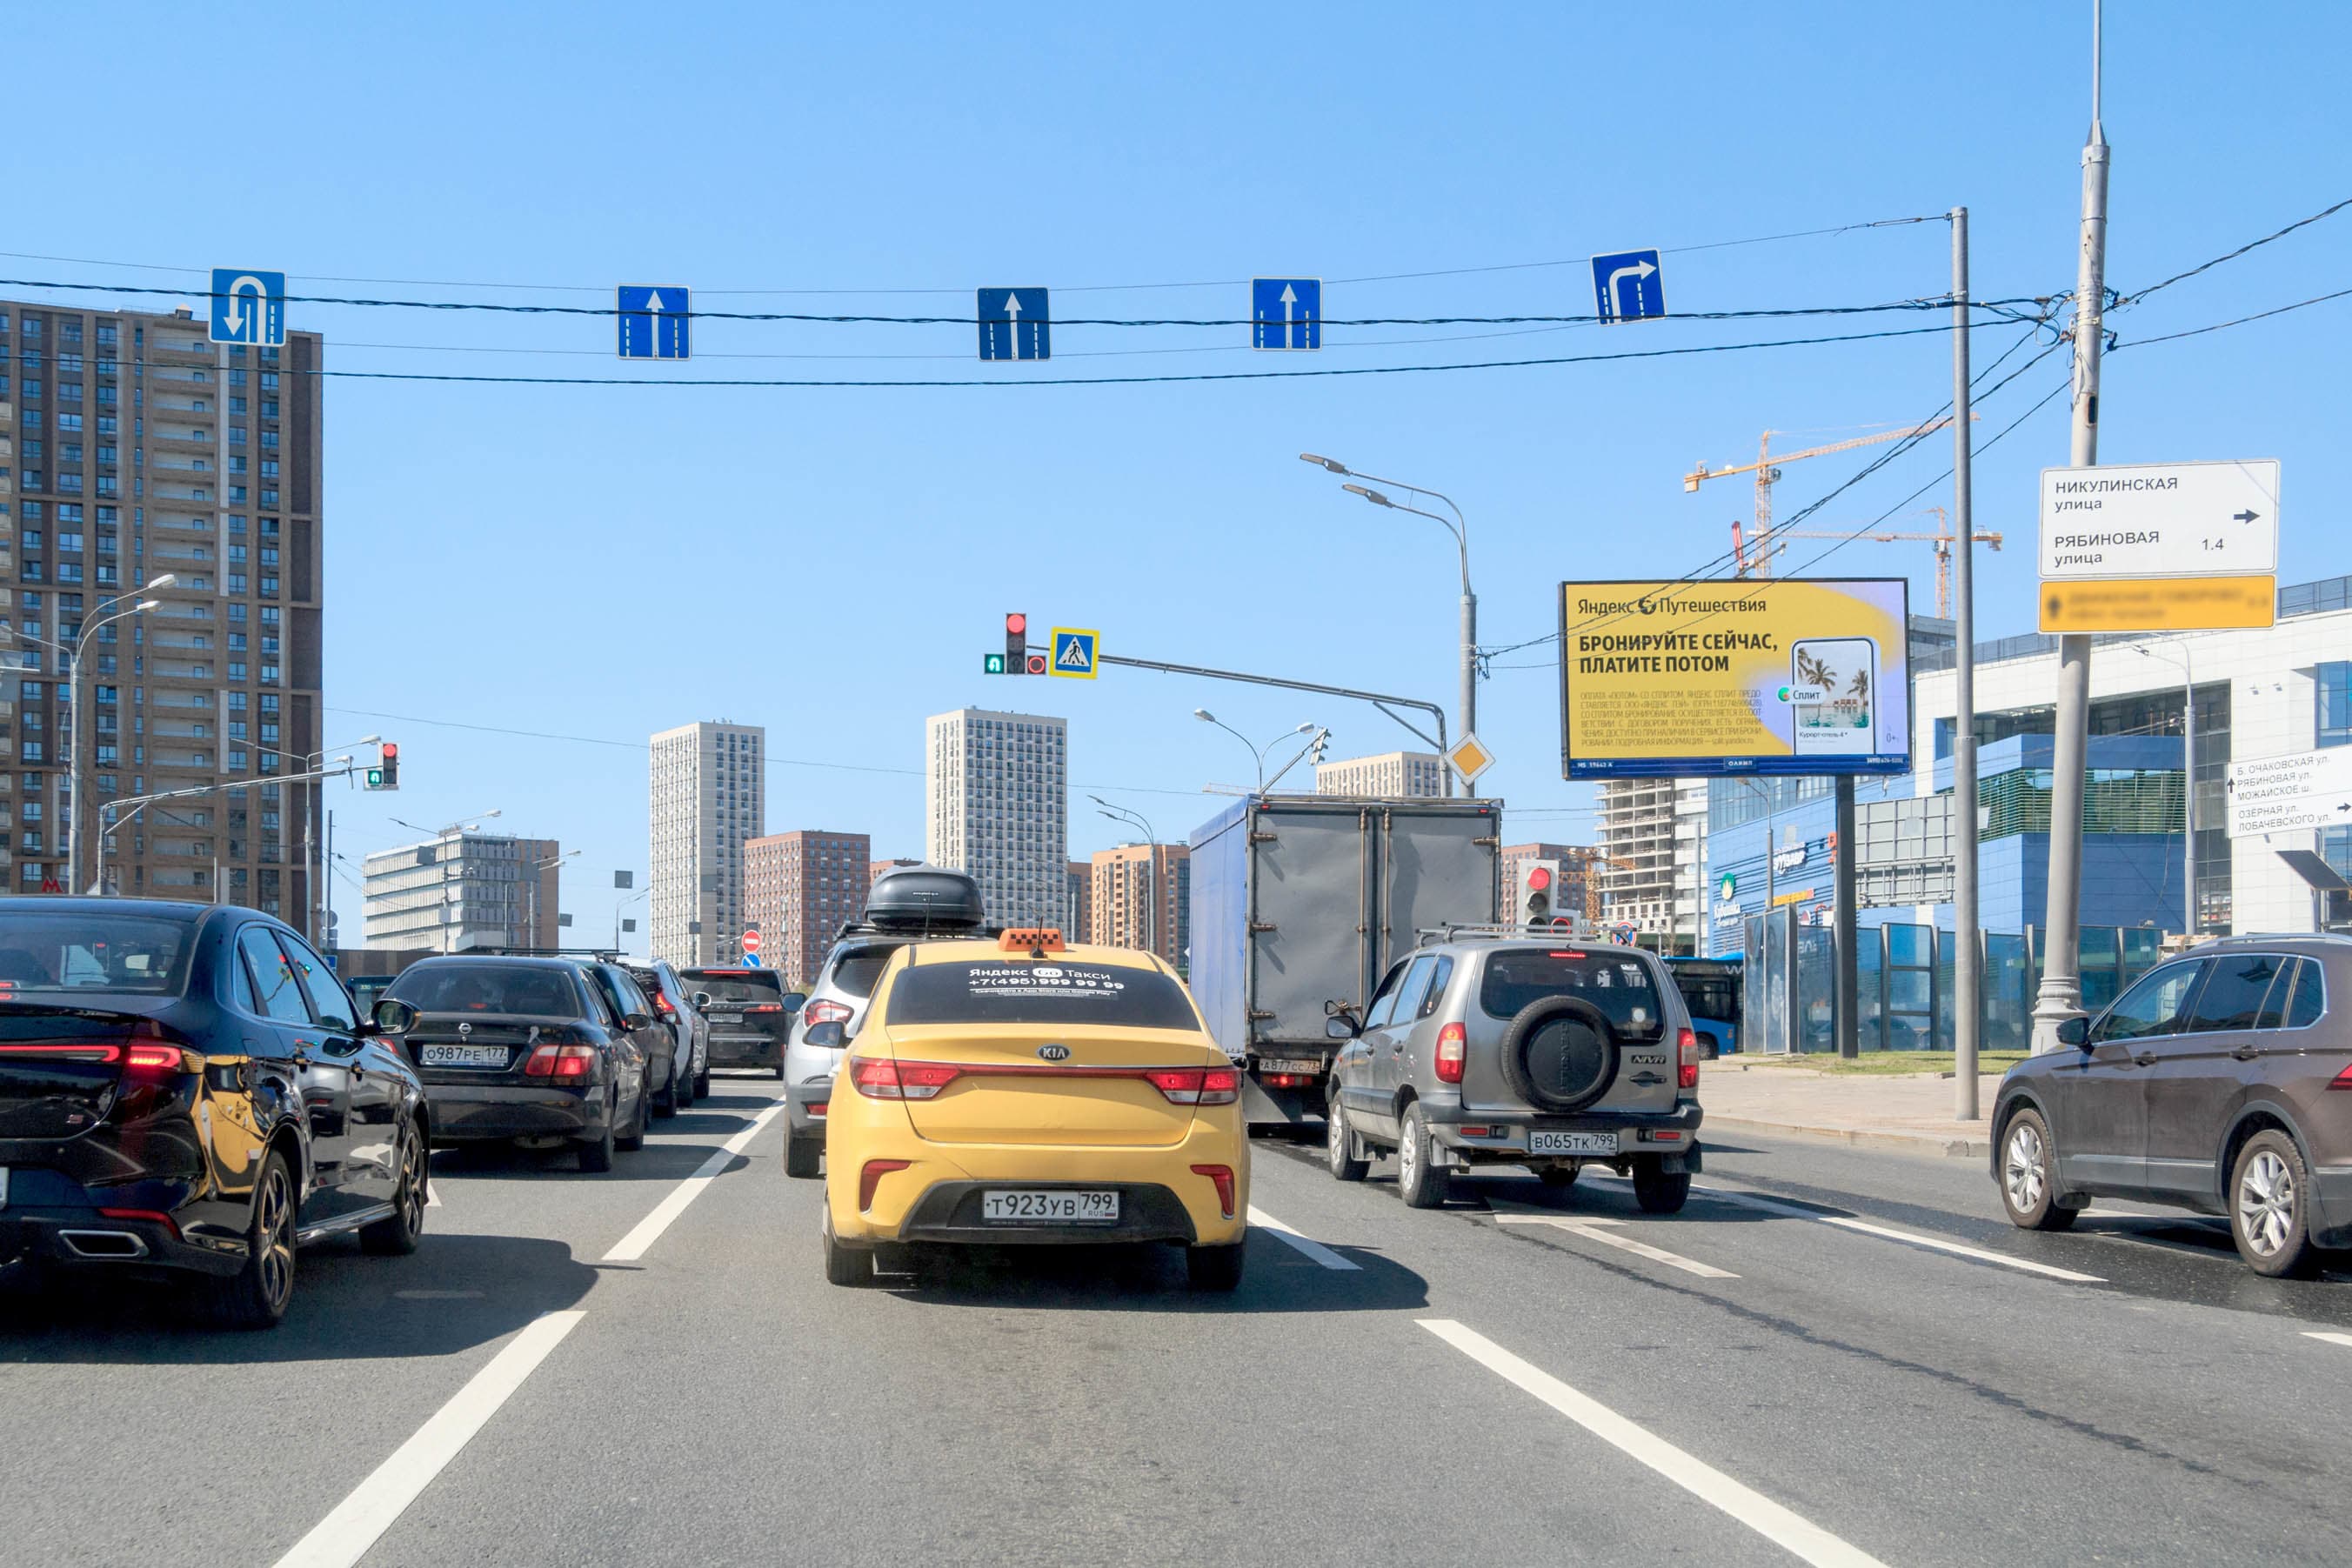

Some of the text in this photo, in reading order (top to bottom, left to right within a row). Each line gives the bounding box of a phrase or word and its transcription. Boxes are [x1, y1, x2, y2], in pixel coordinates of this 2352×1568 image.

[2055, 477, 2178, 494] НИКУЛИНСКАЯ
[2055, 499, 2102, 513] улица
[2055, 531, 2160, 548] РЯБИНОВАЯ
[2202, 538, 2224, 550] 1.4
[2055, 554, 2102, 568] улица
[1578, 597, 1767, 615] Яндекс Путешествия
[1579, 629, 1778, 652] БРОНИРУЙТЕ СЕЙЧАС,
[1580, 655, 1729, 674] ПЛАТИТЕ ПОТОМ
[1793, 690, 1821, 702] Сплит
[2248, 757, 2314, 774] ОЧАКОВСКАЯ
[2237, 772, 2295, 787] РЯБИНОВАЯ
[2238, 814, 2315, 832] ЛОБАЧЕВСКОГО
[969, 968, 1028, 977] Яндекс
[1066, 969, 1111, 981] Такси
[1075, 979, 1097, 988] 99
[1103, 981, 1125, 990] 99
[427, 1047, 504, 1060] О987РЕ 177
[1044, 1047, 1066, 1058] KIA
[1535, 1134, 1614, 1149] В065ТК 799
[992, 1194, 1113, 1216] Т923УВ 799
